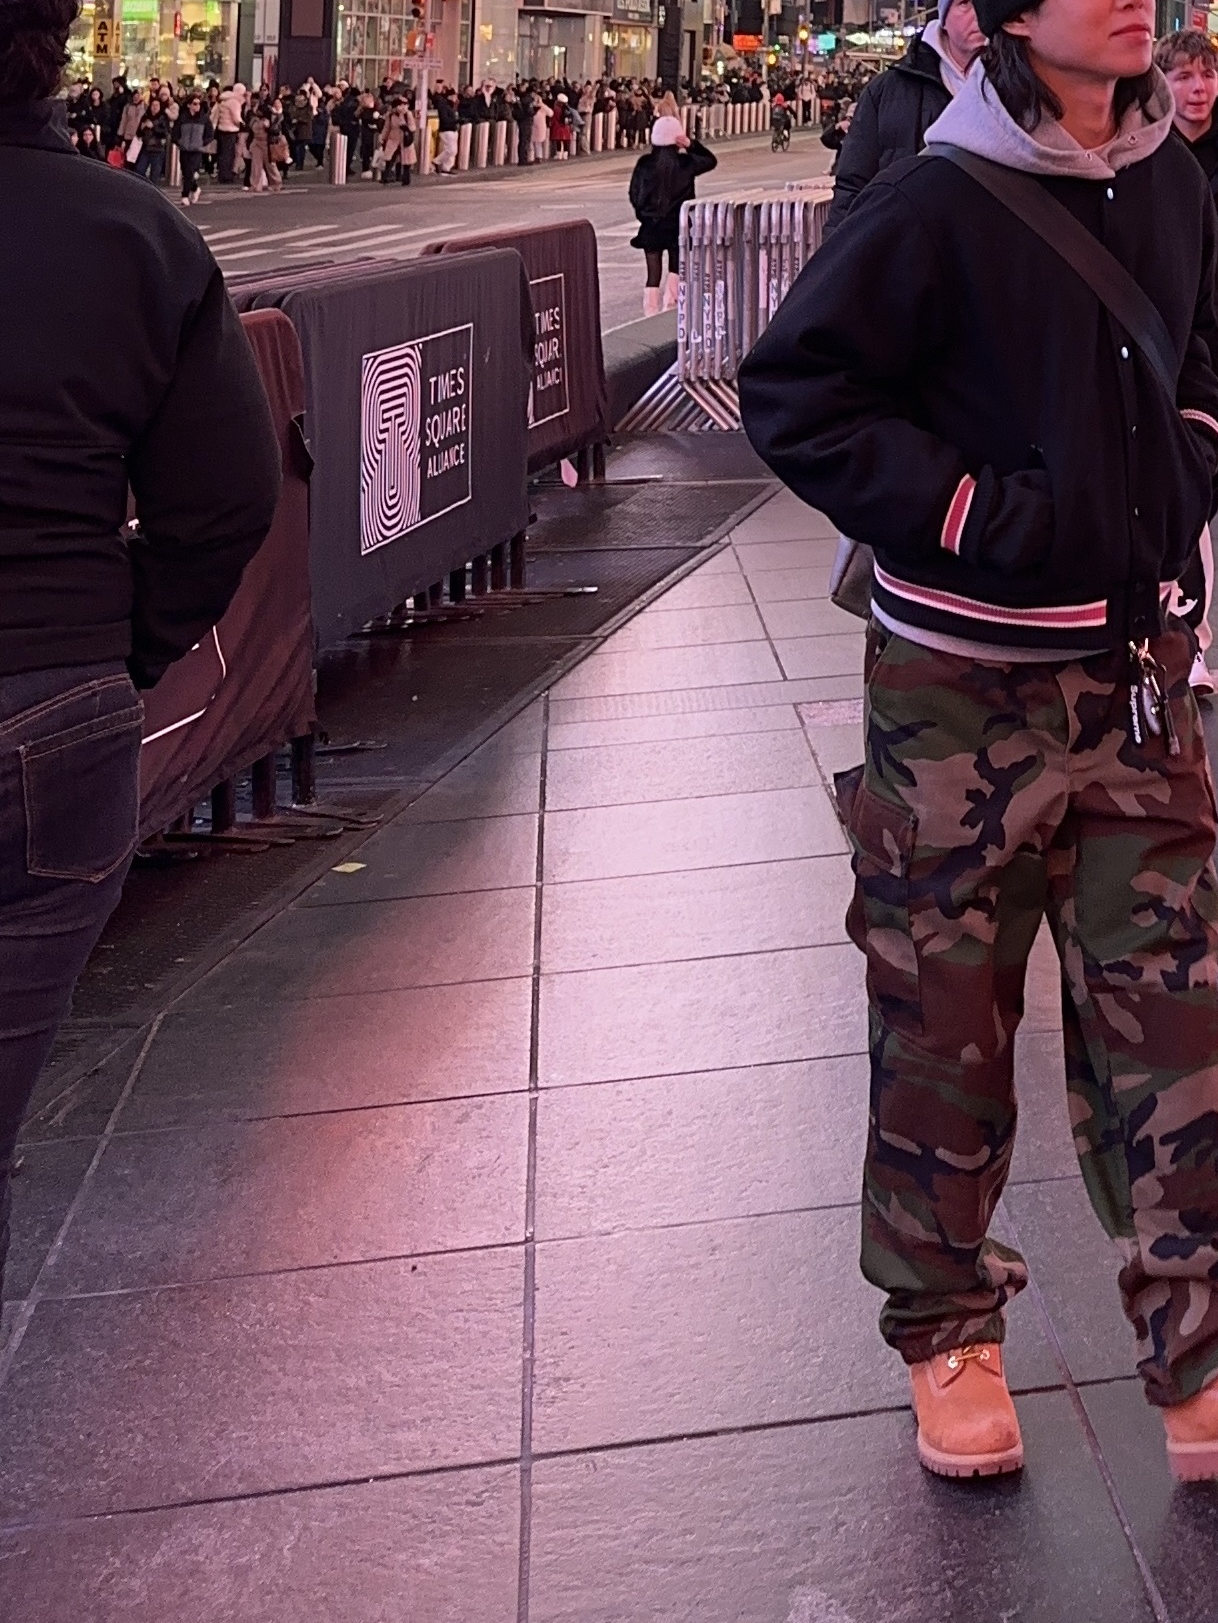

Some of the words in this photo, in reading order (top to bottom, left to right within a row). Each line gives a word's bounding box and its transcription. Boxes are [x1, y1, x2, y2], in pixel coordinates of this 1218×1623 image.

[96, 21, 108, 54] ATM
[535, 307, 560, 335] TIMES
[678, 287, 687, 341] NYPD
[428, 367, 464, 405] TIMES
[425, 403, 466, 448] SQUARE
[427, 443, 465, 479] ALLIANCE
[1129, 685, 1142, 744] Supreme
